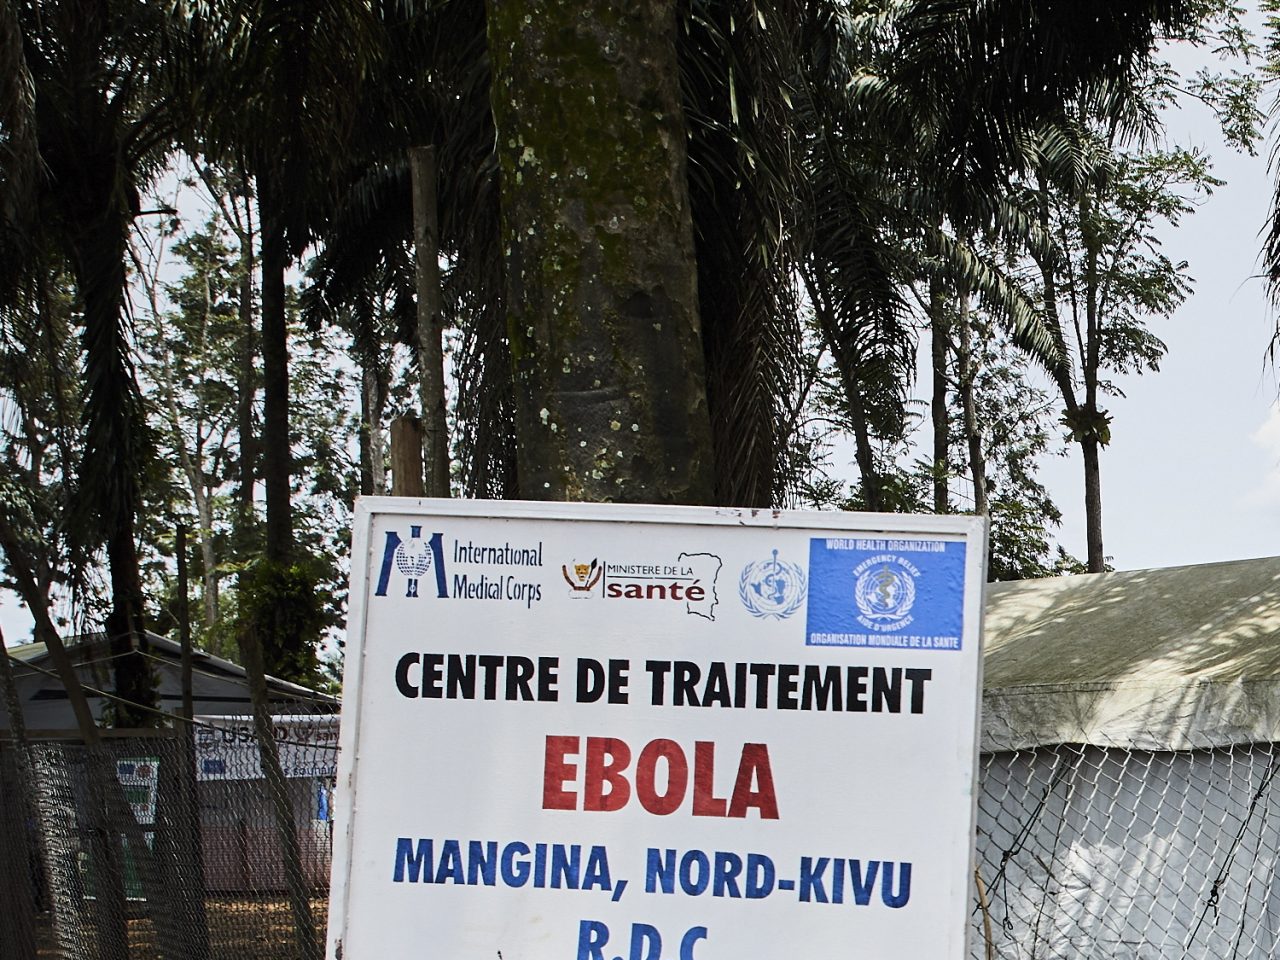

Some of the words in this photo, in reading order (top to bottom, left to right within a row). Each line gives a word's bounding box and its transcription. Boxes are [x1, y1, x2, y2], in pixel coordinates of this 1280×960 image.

[454, 539, 543, 567] International
[826, 538, 855, 550] WORLD
[856, 539, 886, 551] HEALTH
[887, 540, 945, 552] ORGANIZATION
[607, 564, 661, 575] MINISTERE
[664, 566, 678, 576] DE
[681, 567, 694, 576] LA
[853, 554, 897, 576] EMERGENCY
[897, 556, 921, 577] RELIEF
[453, 574, 503, 600] Medical
[506, 575, 542, 609] Corps
[607, 579, 705, 601] santé
[856, 615, 874, 630] AIDE
[874, 614, 915, 632] D'URGENCE
[810, 633, 867, 645] ORGANISATION
[868, 634, 909, 647] MONDIALE
[910, 636, 921, 647] DE
[922, 636, 933, 648] LA
[933, 637, 959, 648] SANTE
[395, 651, 560, 702] CENTRE
[576, 657, 630, 704] DE
[646, 660, 932, 714] TRAITEMENT
[223, 727, 288, 743] USD
[542, 734, 780, 820] EBOLA
[393, 837, 629, 902] MANGINA,
[645, 847, 913, 909] NORD-KIVU
